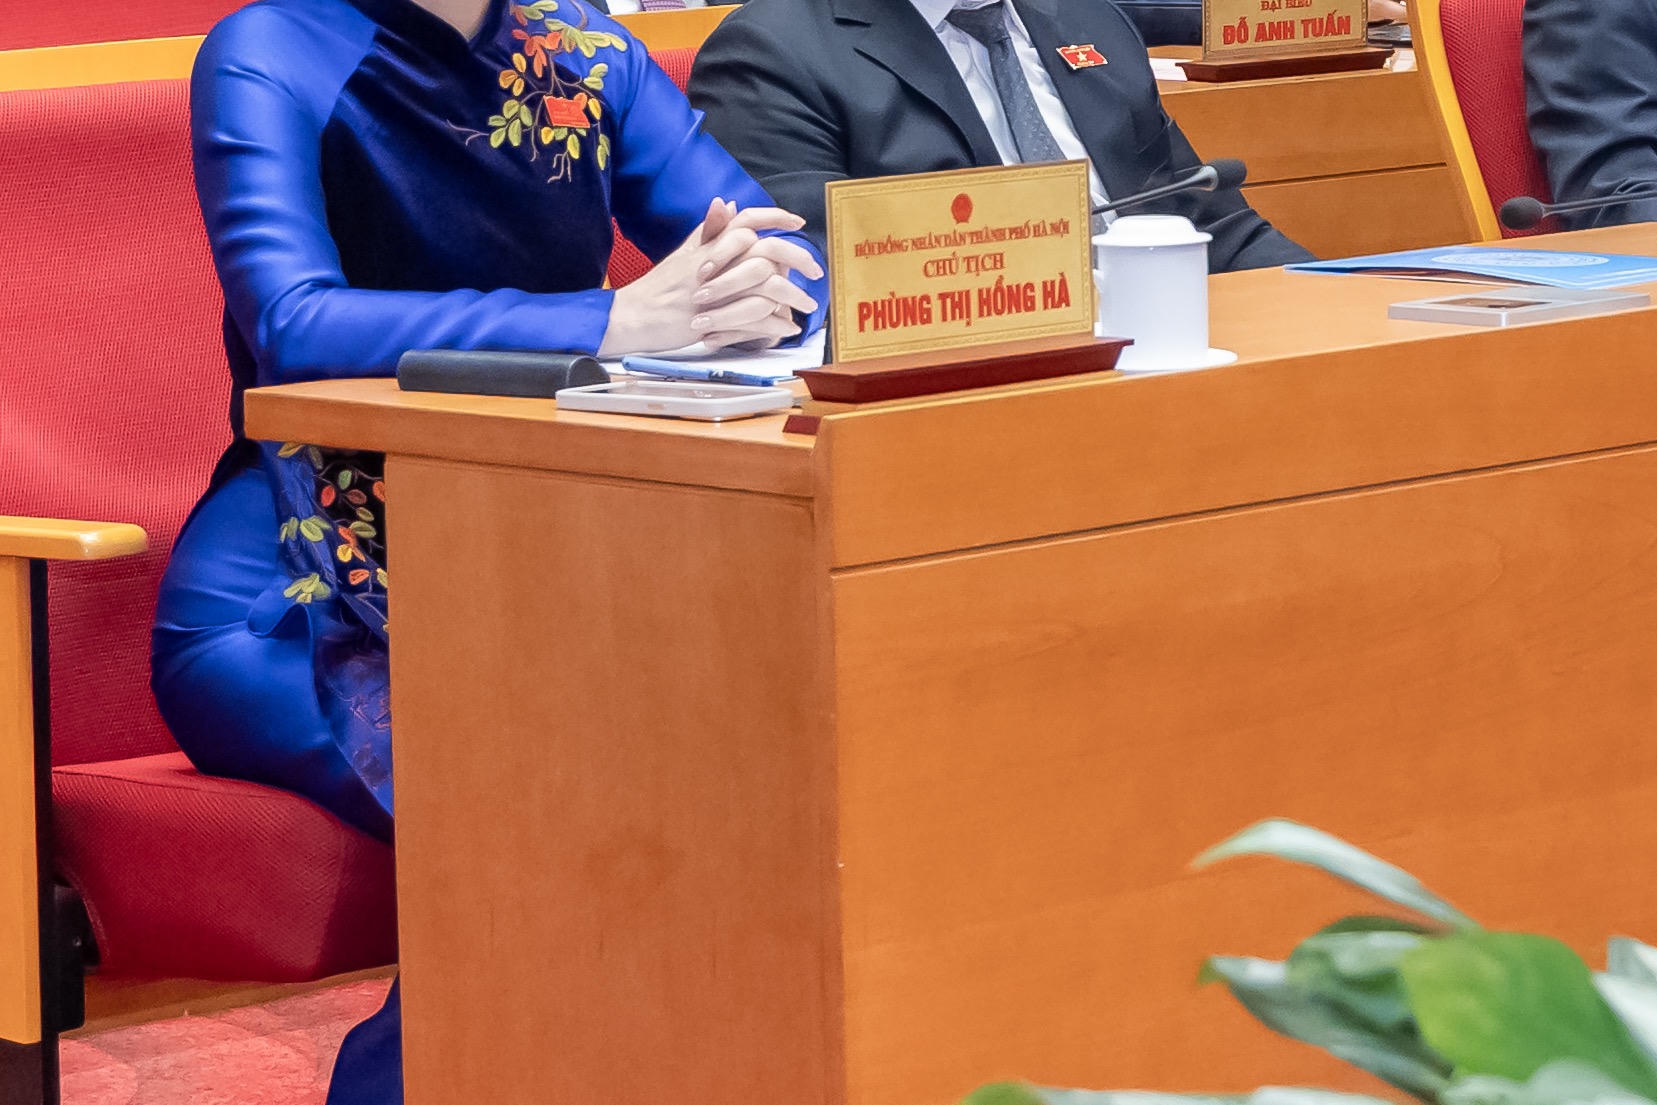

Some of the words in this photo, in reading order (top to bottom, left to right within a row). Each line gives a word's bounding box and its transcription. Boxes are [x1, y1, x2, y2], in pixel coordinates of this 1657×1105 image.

[1222, 16, 1249, 45] ĐỖ
[1255, 19, 1295, 43] ANH
[1301, 9, 1351, 39] TUẤN
[911, 231, 943, 251] NHÂN
[965, 227, 1005, 246] THÀNH
[1008, 220, 1030, 240] PHỐ
[1033, 220, 1047, 237] HÀ
[1050, 218, 1070, 238] NỘI
[923, 251, 959, 278] CHỦ
[963, 252, 1005, 277] TỊCH
[857, 291, 932, 333] PHÙNG
[938, 288, 972, 327] THỊ
[977, 275, 1036, 319] HỒNG
[1042, 272, 1071, 310] HÀ
